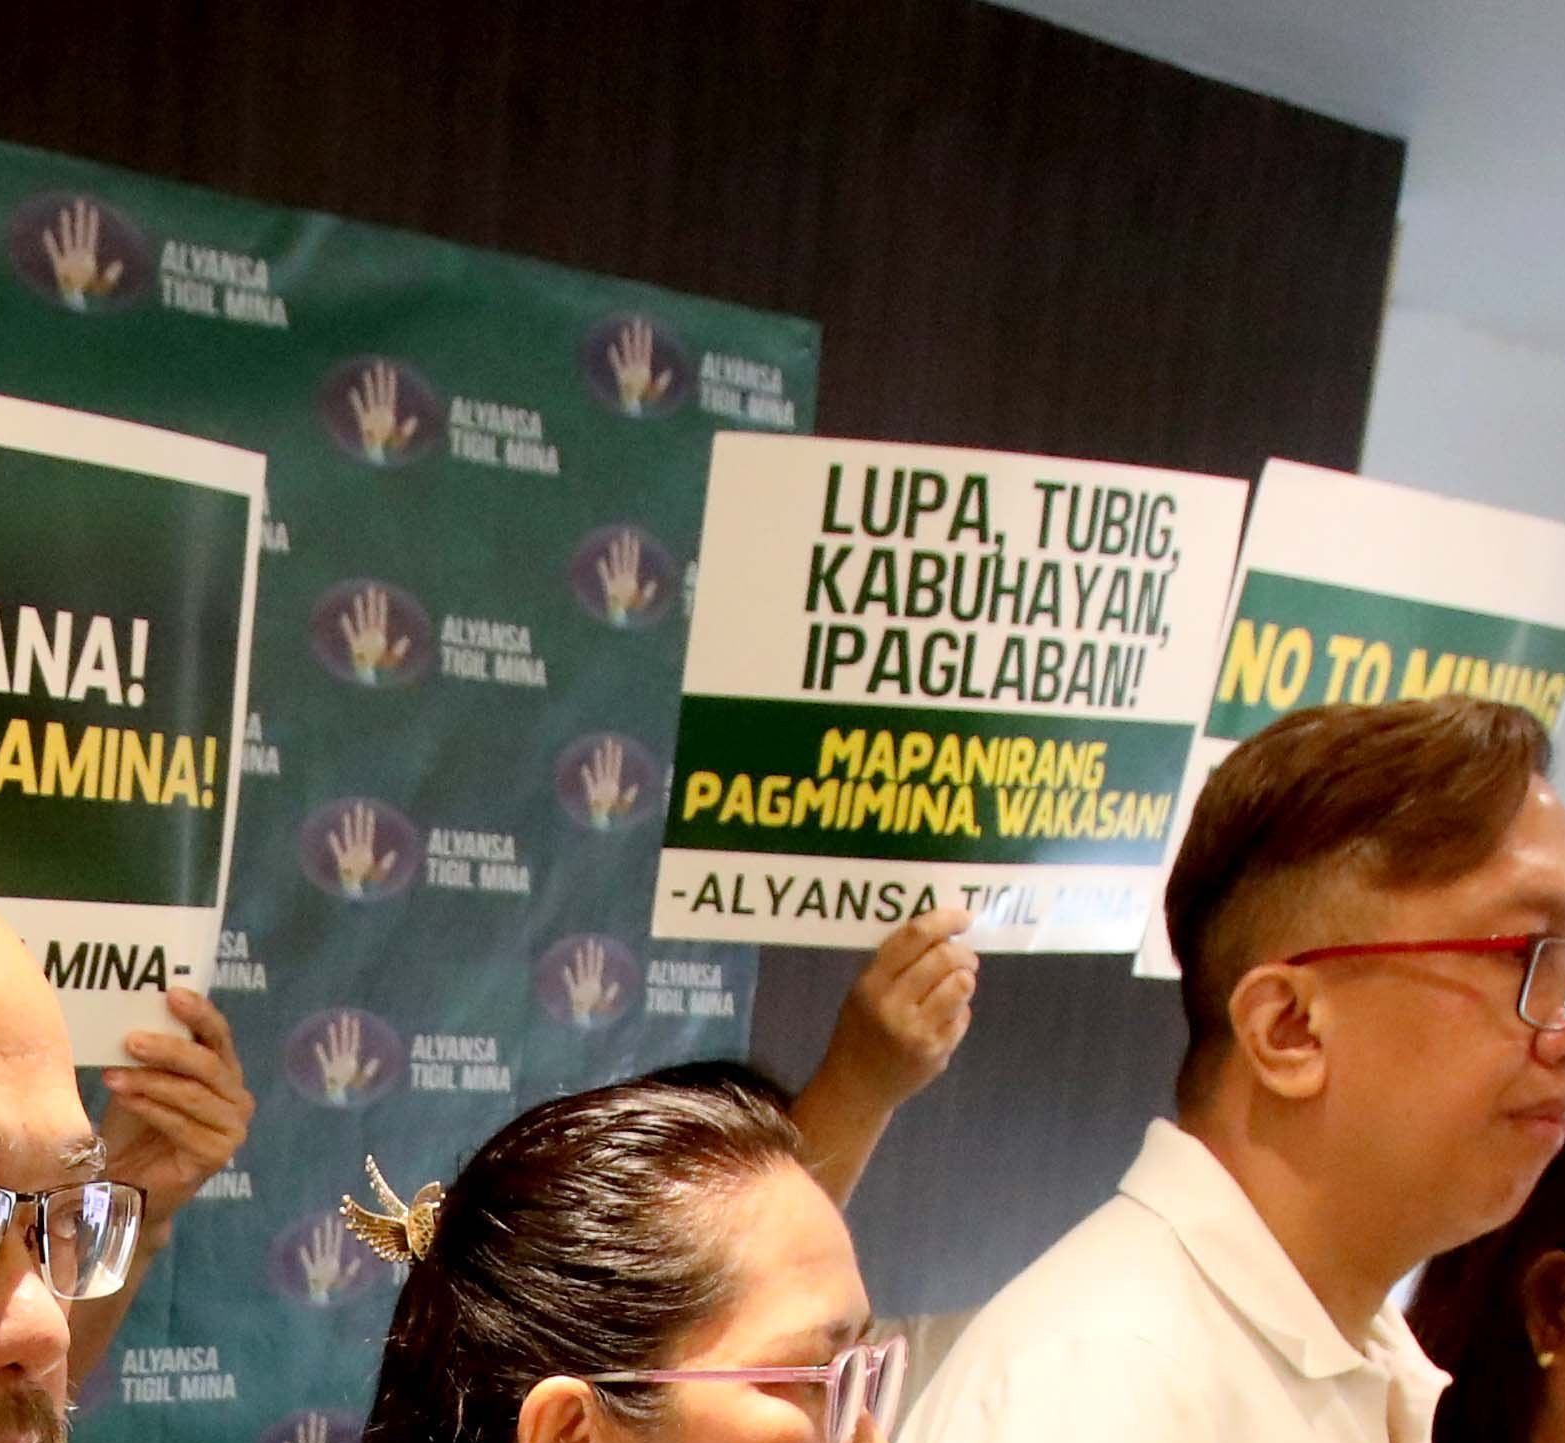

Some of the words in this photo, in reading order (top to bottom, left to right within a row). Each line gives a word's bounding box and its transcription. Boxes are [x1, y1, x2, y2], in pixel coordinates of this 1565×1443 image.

[160, 240, 269, 289] ALYANSA
[160, 276, 218, 316] TIGIL
[224, 287, 289, 328] MINA
[449, 397, 543, 441] ALYANSA
[450, 430, 501, 467] TIGIL
[505, 437, 561, 475] MINA
[821, 463, 1004, 556] LUPA,
[1034, 480, 1182, 573] TUBIG,
[804, 544, 1171, 649] KABUHAYAN,
[441, 614, 532, 655] ALYANSA
[441, 647, 492, 680] TIGIL
[494, 653, 548, 688] MINA
[801, 622, 1149, 708] IPAGLABAN!
[1218, 619, 1311, 709] NO
[1325, 634, 1391, 707] TO
[818, 727, 1107, 788] MAPANIRANG
[996, 786, 1171, 841] WAKASAN!
[427, 828, 516, 861] ALYANSA
[427, 857, 475, 890] TIGIL
[479, 861, 531, 894] MINA
[44, 939, 191, 991] MINA-
[410, 1034, 498, 1064] ALYANSA
[410, 1061, 459, 1089] TIGIL
[462, 1064, 512, 1093] MINA
[122, 1346, 219, 1374] ALYANSA
[123, 1376, 170, 1403] TIGIL
[179, 1373, 236, 1400] MINA
